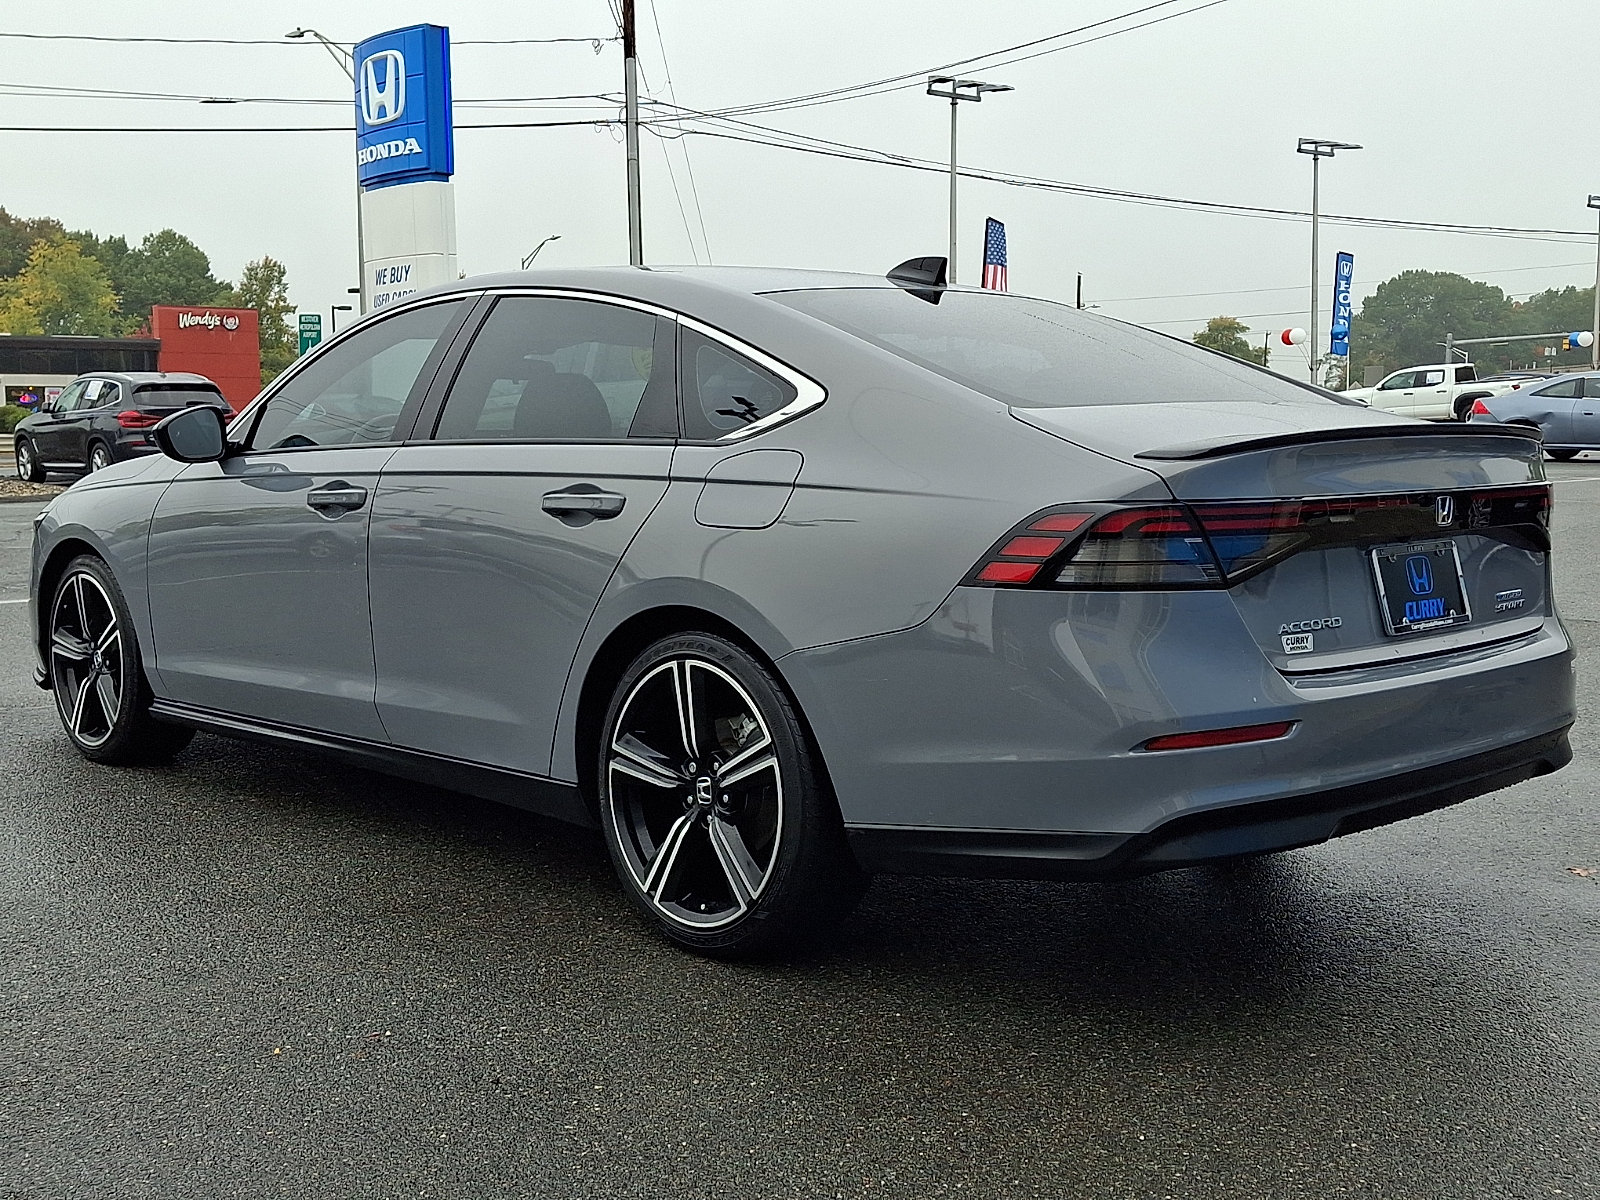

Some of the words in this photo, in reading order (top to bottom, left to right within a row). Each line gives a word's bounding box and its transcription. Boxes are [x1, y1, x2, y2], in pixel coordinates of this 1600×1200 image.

[357, 138, 423, 166] HONDA
[375, 268, 388, 286] WE
[390, 264, 411, 284] BUY
[178, 311, 221, 330] Wendy's
[1405, 598, 1445, 620] CURRY
[1278, 616, 1342, 634] ACCORD
[1285, 635, 1310, 646] CURRY
